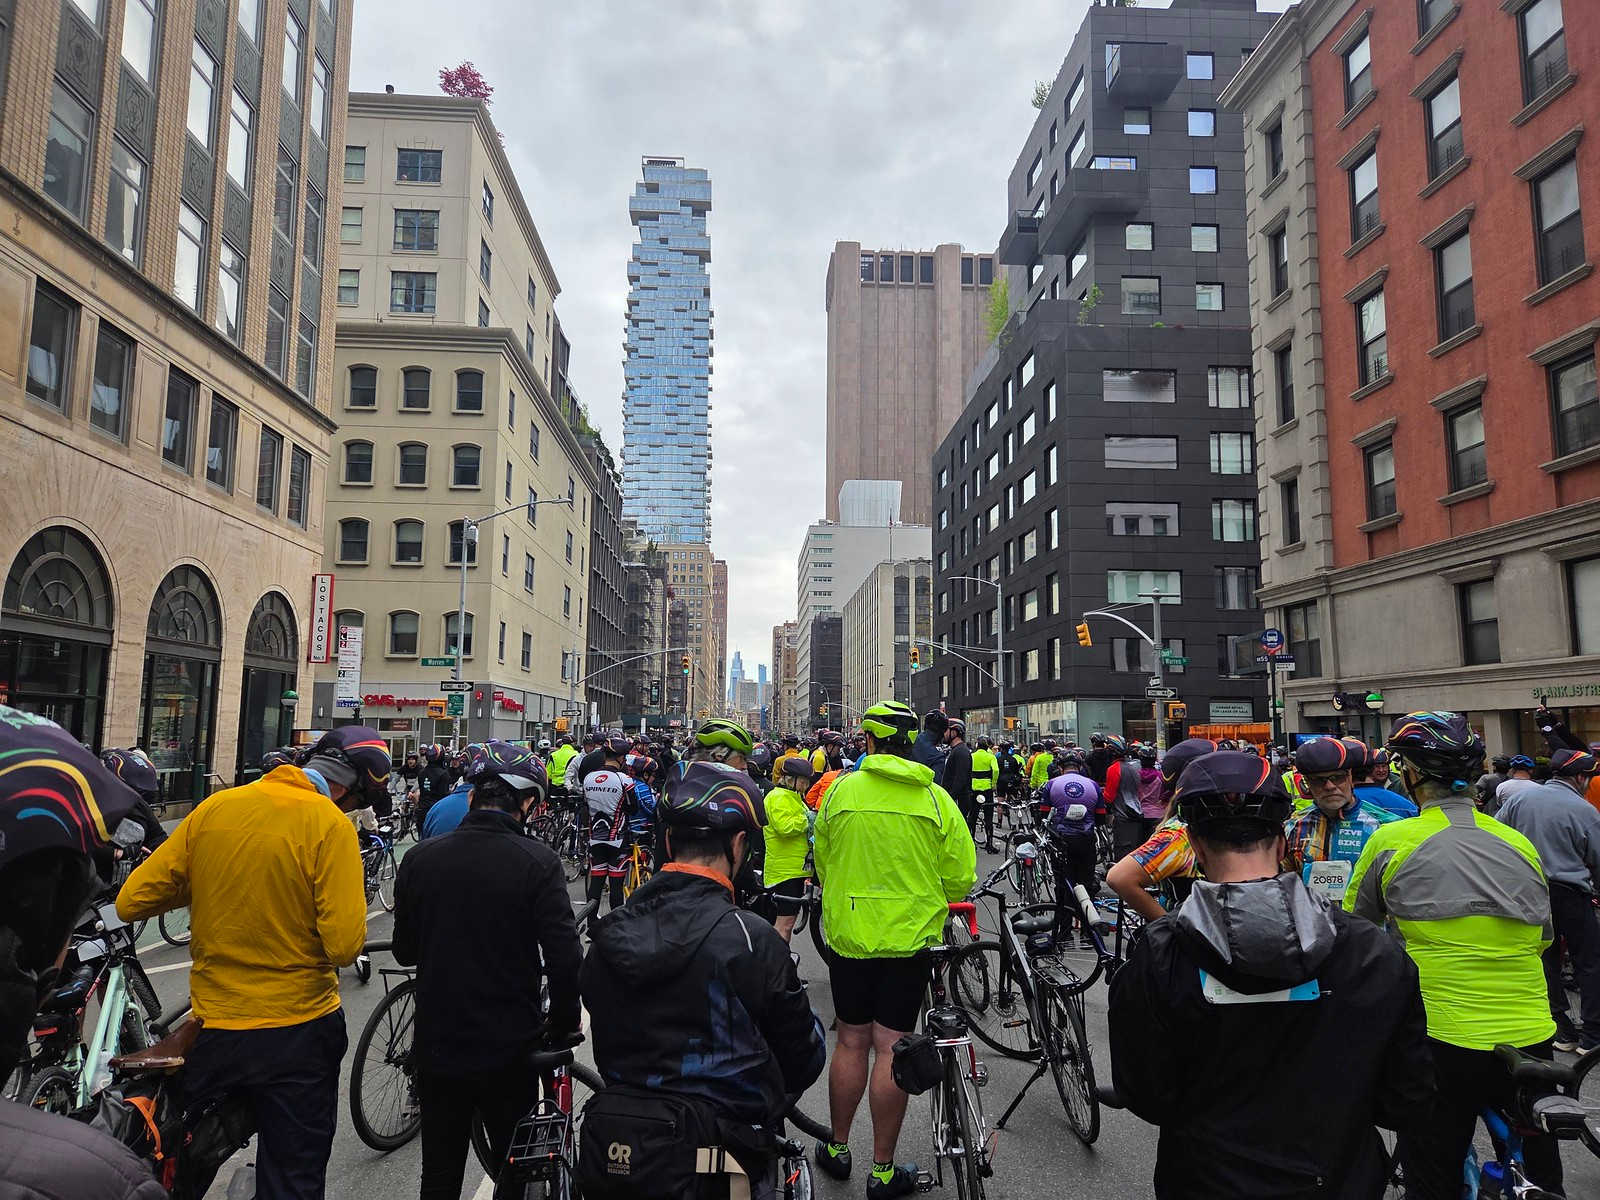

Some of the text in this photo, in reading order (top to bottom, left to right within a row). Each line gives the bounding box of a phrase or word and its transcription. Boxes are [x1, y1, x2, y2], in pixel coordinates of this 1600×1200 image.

[319, 577, 327, 602] LOS
[316, 607, 325, 651] TACOS
[363, 694, 395, 707] CVS
[396, 696, 434, 708] pharm
[1338, 839, 1361, 847] BIKE
[1313, 875, 1344, 884] 20878
[608, 1141, 632, 1164] OR
